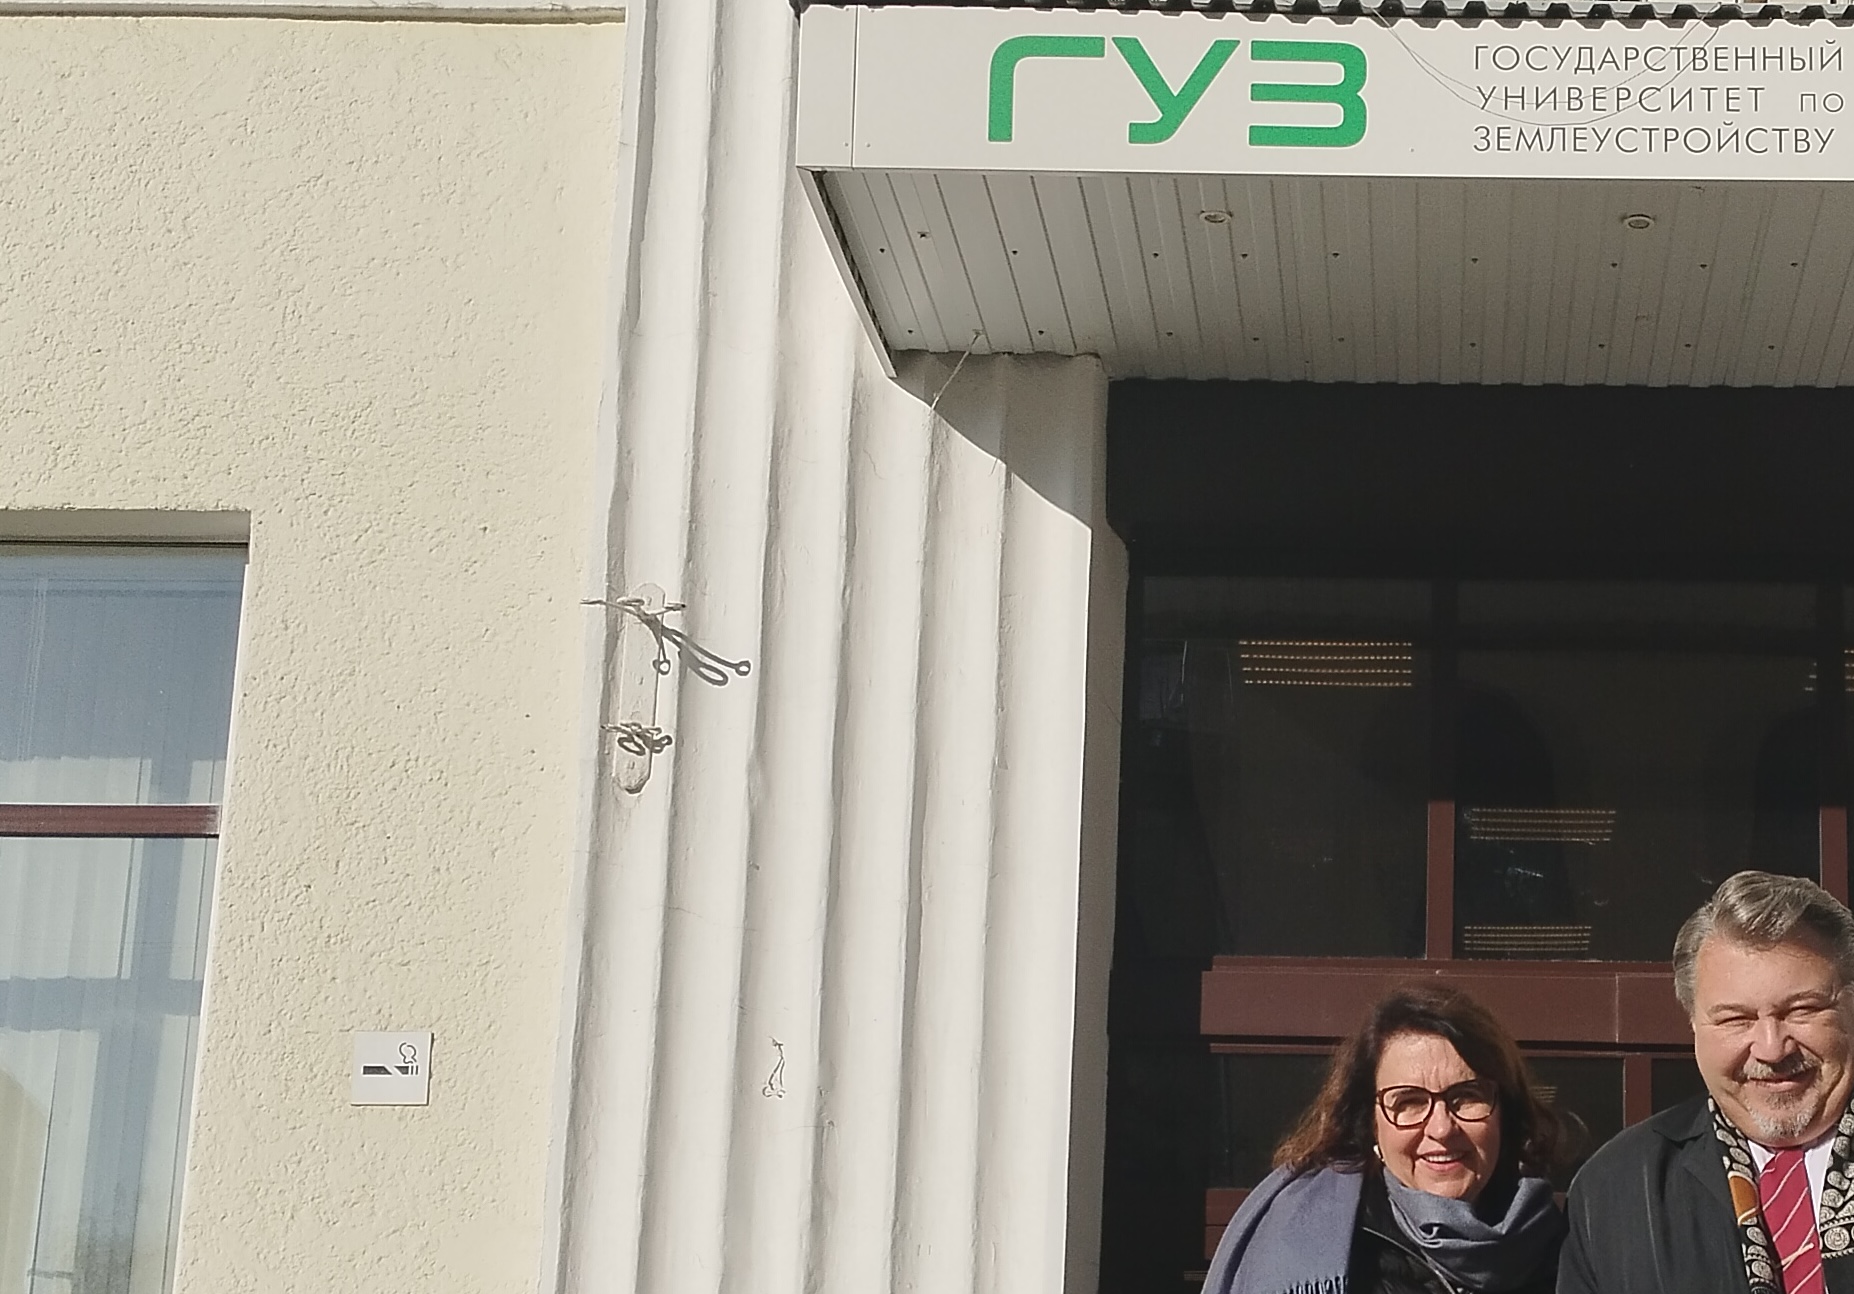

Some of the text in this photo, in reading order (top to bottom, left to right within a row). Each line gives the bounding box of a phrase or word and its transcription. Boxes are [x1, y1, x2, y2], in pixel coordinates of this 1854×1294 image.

[1474, 39, 1843, 75] ГОСУДАРСТВЕННЫЙ
[988, 34, 1368, 147] ГУЗ
[1476, 86, 1845, 113] УНИВЕРСИТЕТ по
[1473, 121, 1835, 154] ЗЕМЛЕУСТРОЙСТВУ
